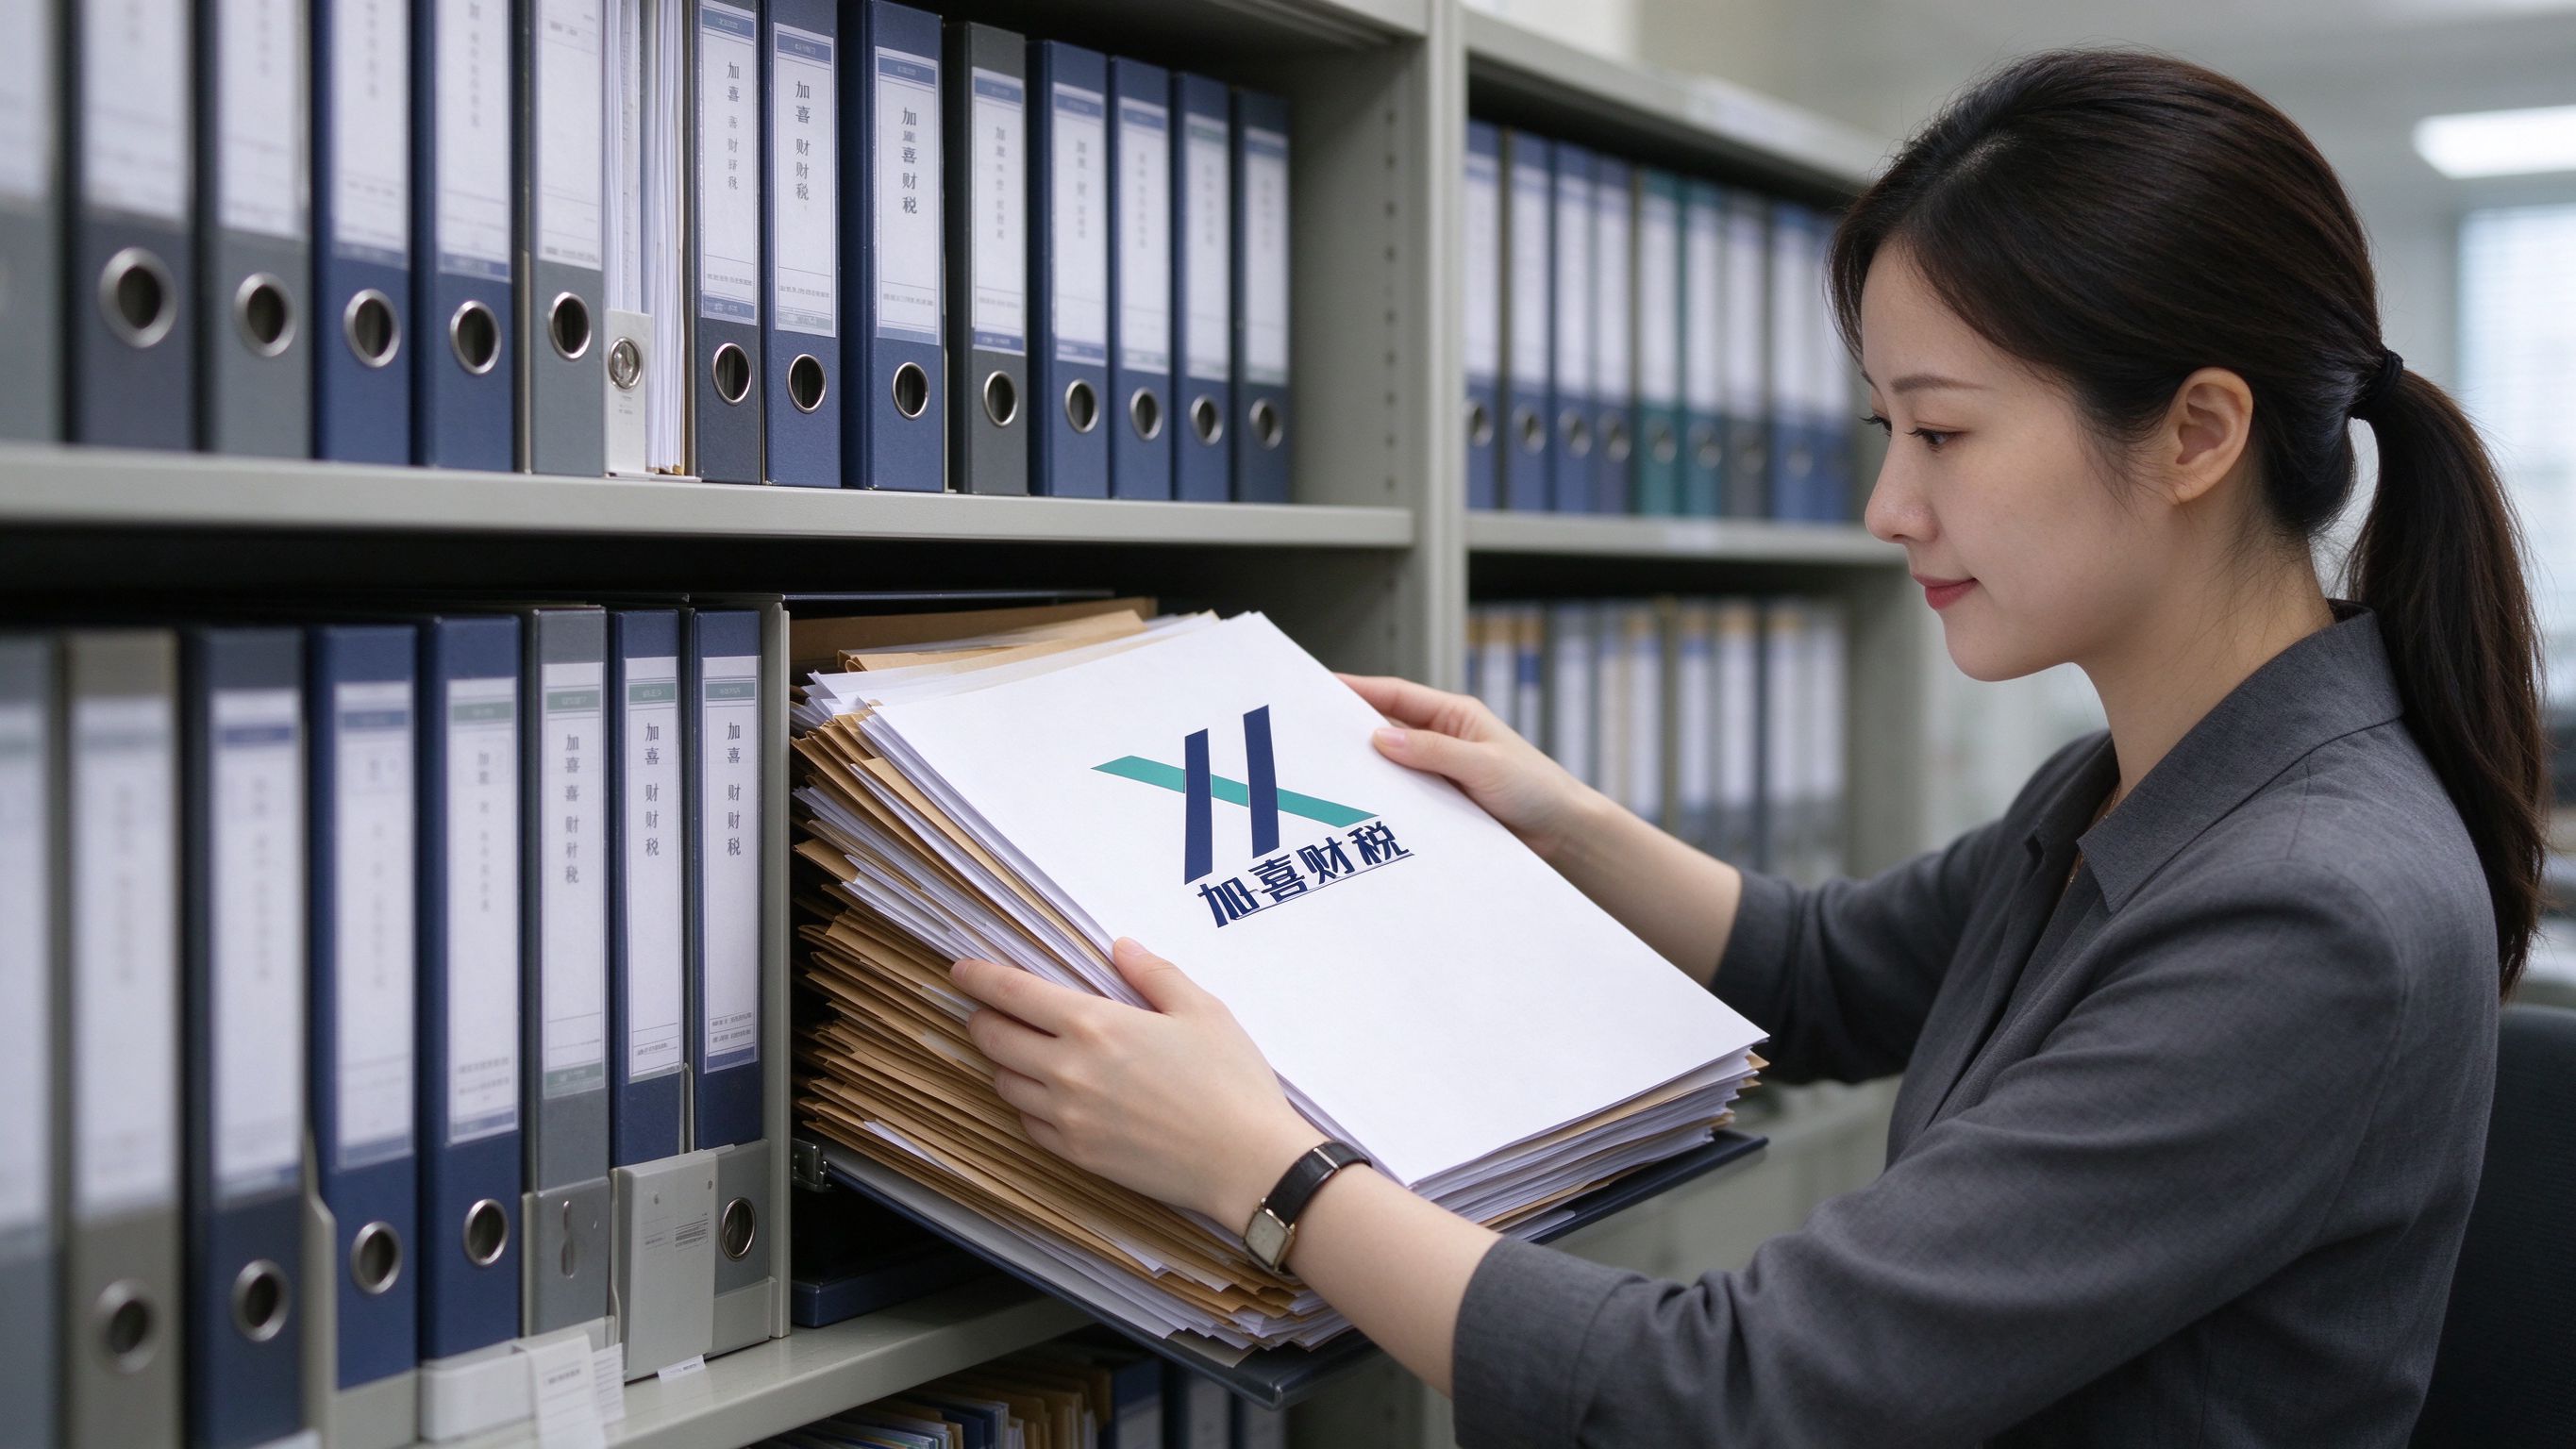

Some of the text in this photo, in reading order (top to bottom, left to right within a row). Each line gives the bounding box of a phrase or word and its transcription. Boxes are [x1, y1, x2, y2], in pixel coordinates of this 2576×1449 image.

[727, 722, 741, 857] 加喜财财税
[1197, 821, 1410, 927] 加喜财税
